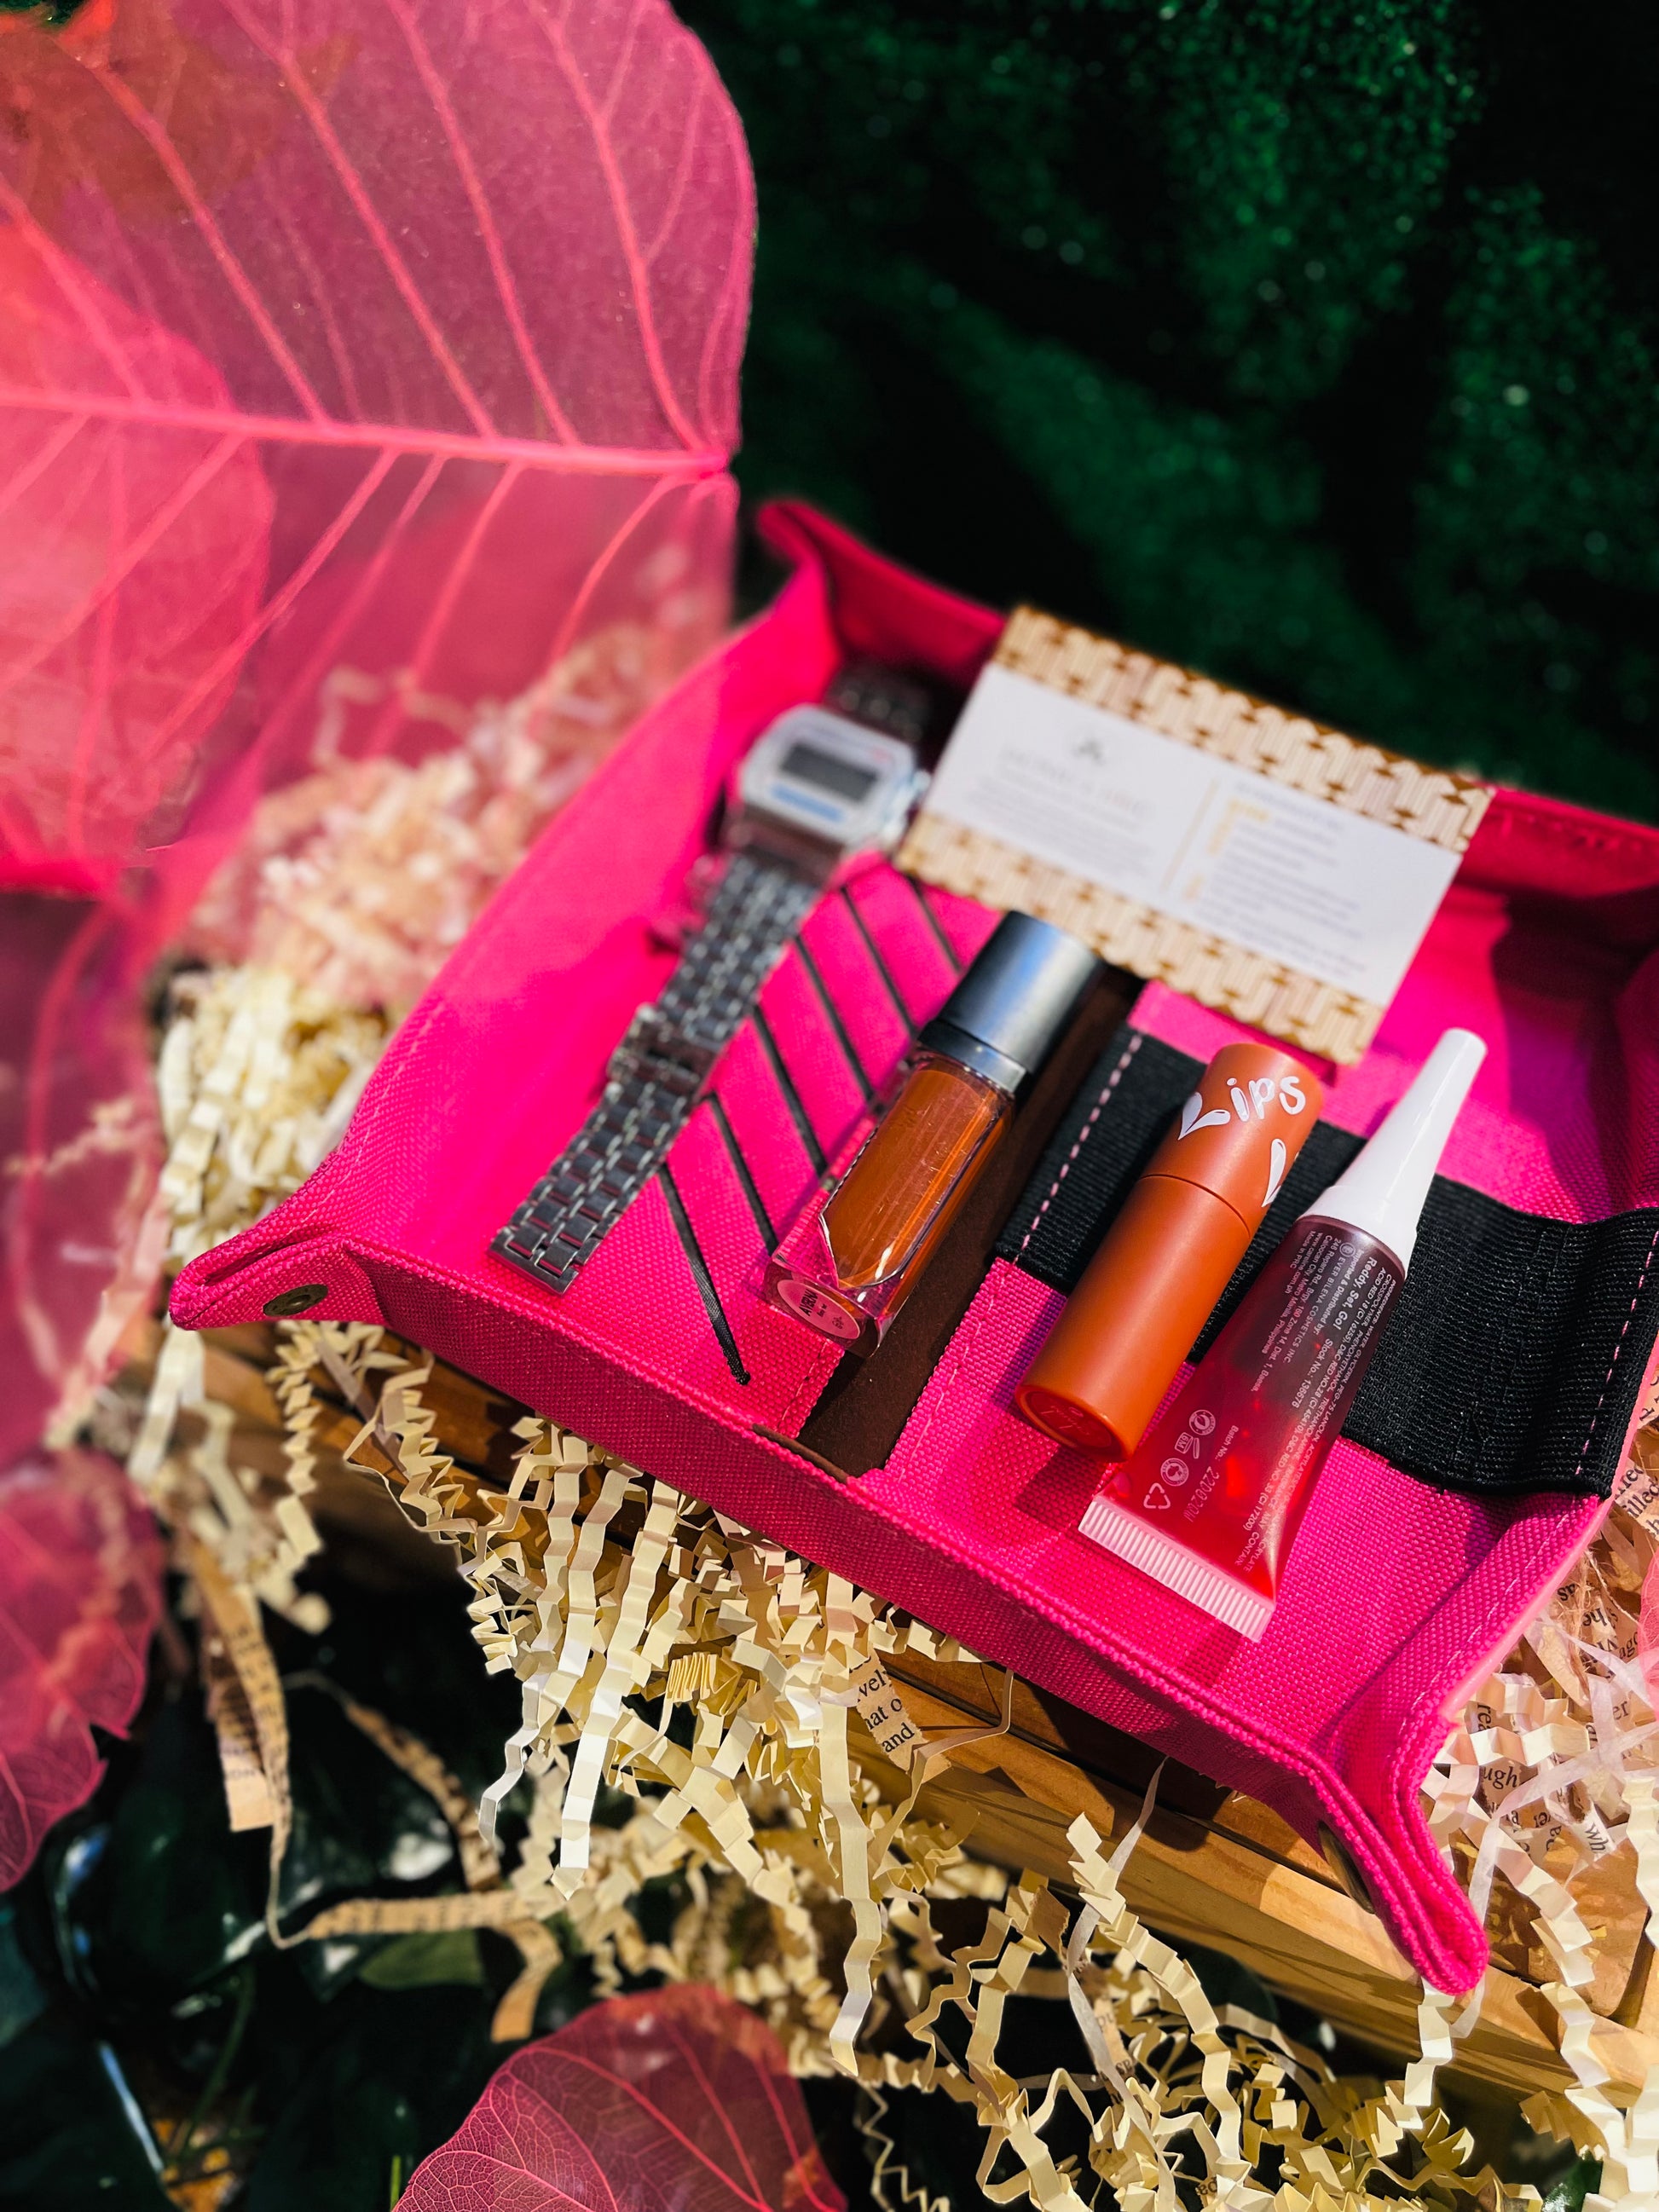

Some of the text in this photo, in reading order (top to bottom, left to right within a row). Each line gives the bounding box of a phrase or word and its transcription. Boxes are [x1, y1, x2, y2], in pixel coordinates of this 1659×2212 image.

[1177, 1075, 1305, 1141] Lips
[1301, 1228, 1315, 1248] Made
[1312, 1233, 1332, 1264] Caloocan
[1288, 1252, 1302, 1270] PRC
[1343, 1247, 1364, 1279] Imported
[1351, 1256, 1378, 1291] Reddy,
[1373, 1266, 1387, 1285] ACID
[1293, 1276, 1308, 1297] Metro
[1366, 1284, 1378, 1299] RED
[1280, 1295, 1298, 1320] Manila,
[1319, 1285, 1344, 1324] Distributed
[1341, 1288, 1360, 1310] Set,
[1360, 1273, 1393, 1327] CROSSPOLYMER,
[1361, 1298, 1370, 1308] 18
[1370, 1279, 1397, 1325] INGREDIENTS:
[1281, 1256, 1345, 1365] EVER BILENA COSMETICS INC.
[1332, 1309, 1349, 1330] Go!
[1260, 1318, 1285, 1355] Philippines
[1283, 1317, 1297, 1335] Zone
[1311, 1321, 1324, 1336] by:
[1276, 1334, 1287, 1346] 14,
[1315, 1337, 1333, 1361] Stock
[1326, 1329, 1364, 1394] PHENOXYETHANOL,
[1333, 1343, 1347, 1361] D&C
[1306, 1360, 1321, 1378] No.:
[1326, 1360, 1338, 1376] RED
[1340, 1349, 1362, 1383] GLYCERIN,
[1306, 1395, 1319, 1409] (CI
[1327, 1383, 1345, 1411] PEG-75
[1223, 1424, 1239, 1447] Batch
[1310, 1410, 1332, 1443] LANOLIN,
[1176, 1434, 1189, 1448] 6M
[1285, 1434, 1298, 1453] D&C
[1214, 1445, 1228, 1462] No.:
[1276, 1451, 1290, 1468] RED
[1263, 1481, 1274, 1493] 33
[1255, 1491, 1269, 1505] (CI
[1241, 1504, 1262, 1531] 17200)
[1257, 1510, 1271, 1529] MAY
[882, 1722, 915, 1753] and
